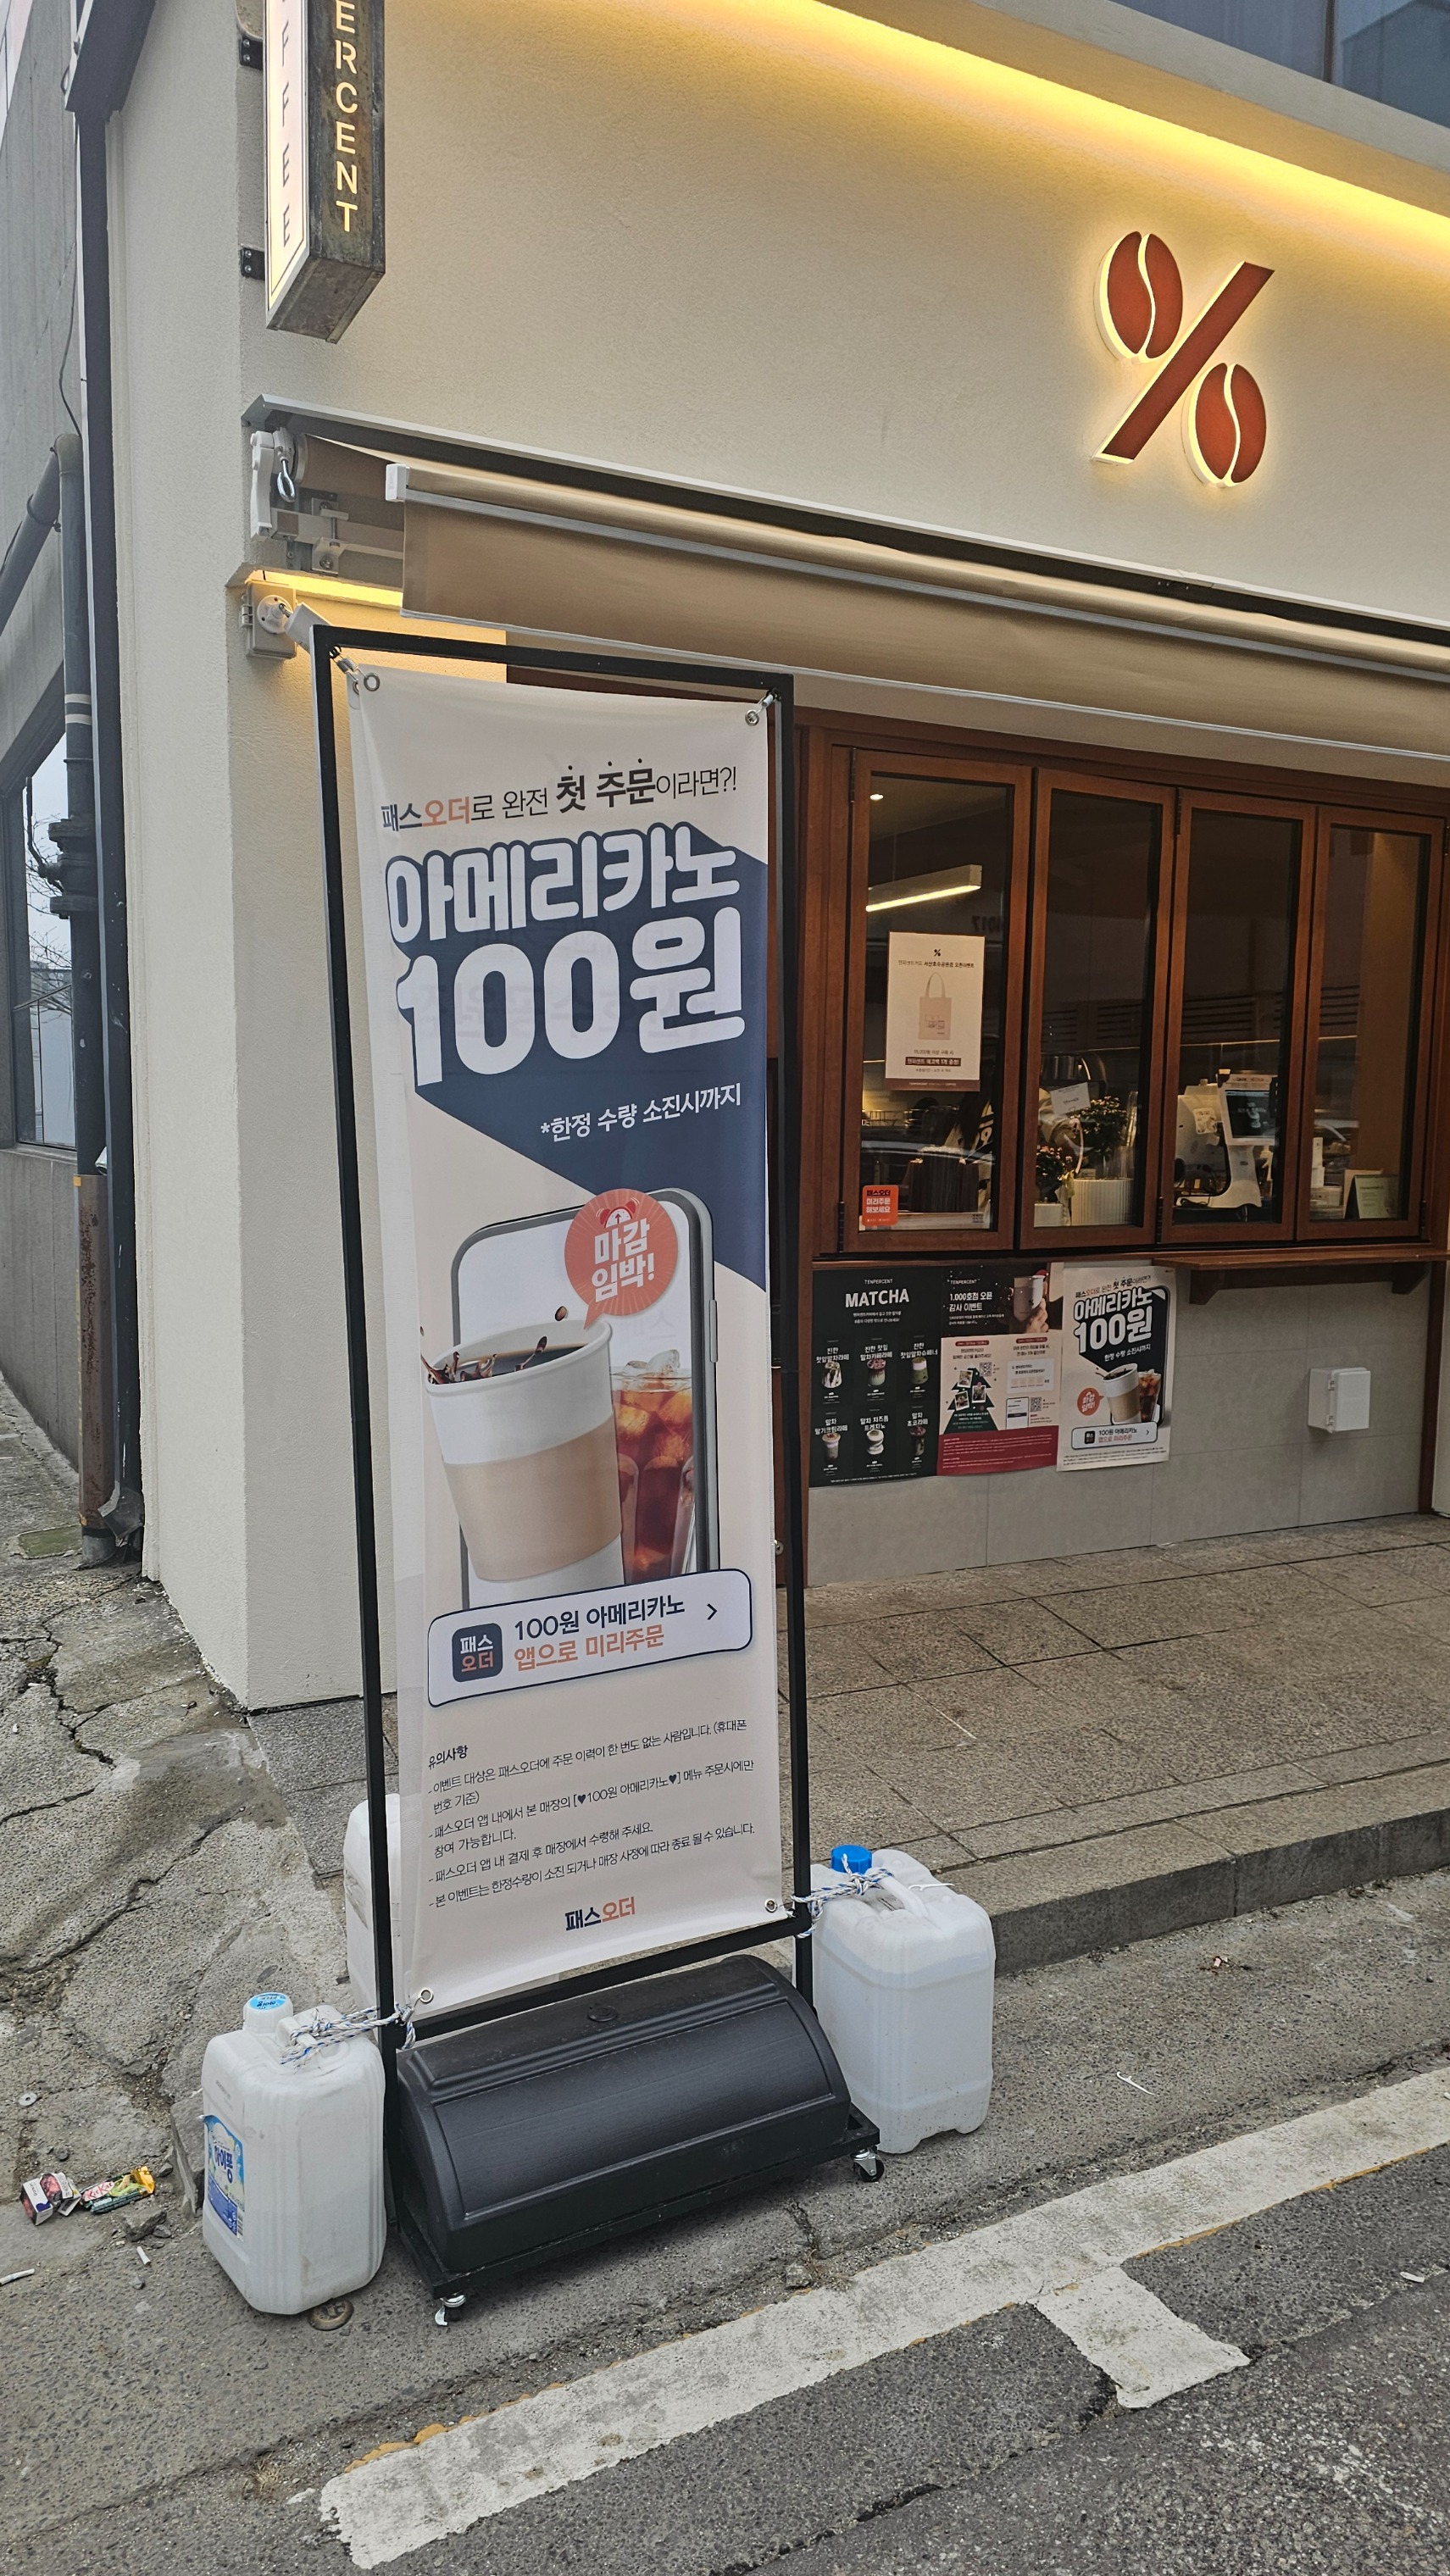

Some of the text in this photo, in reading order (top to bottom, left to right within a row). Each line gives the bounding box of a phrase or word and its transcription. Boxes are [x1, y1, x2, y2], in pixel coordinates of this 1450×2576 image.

[281, 0, 290, 247] FFEE
[381, 766, 736, 831] 패스오더로 완전 첫 주문이라면?!
[386, 824, 741, 944] 아메리카노
[396, 906, 746, 1086] 100원
[597, 1103, 637, 1132] 수량
[642, 1083, 741, 1123] 소진시까지
[866, 1197, 891, 1206] 미리주문
[594, 1218, 650, 1265] 마감
[592, 1252, 655, 1302] 임박!
[845, 1288, 910, 1308] MATCHA
[980, 1291, 993, 1301] 오픈
[1113, 1280, 1119, 1289] 첫
[949, 1302, 983, 1313] 감사 이벤트
[1074, 1286, 1153, 1321] 아메리카노
[1074, 1306, 1153, 1353] 100원
[1126, 1344, 1151, 1356] 소진시까지
[514, 1594, 685, 1641] 100원 아메리카노
[459, 1634, 494, 1655] 패스
[461, 1654, 495, 1674] 오더
[514, 1624, 665, 1672] 앱으로 미리주문
[428, 1745, 468, 1769] 유의사항
[464, 1768, 496, 1785] 대상은
[498, 1757, 550, 1778] 패스오더에
[553, 1752, 574, 1768] 주문
[575, 1745, 605, 1762] 이력이
[608, 1743, 619, 1757] 한
[620, 1739, 640, 1754] 번도
[642, 1735, 662, 1749] 없는
[663, 1724, 712, 1743] 사람입니다.
[714, 1719, 747, 1735] (휴대폰
[433, 1790, 480, 1815] 번호 기준)
[477, 1814, 489, 1828] 앱
[492, 1806, 524, 1824] 내에서
[525, 1804, 536, 1817] 본
[540, 1796, 570, 1813] 매장의
[683, 1768, 703, 1781] 메뉴
[704, 1759, 754, 1777] 주문시에만
[435, 1829, 517, 1859] 참여 가능합니다.
[436, 1895, 446, 1908] 본
[447, 1885, 489, 1903] 이벤트는
[492, 1871, 542, 1894] 한정수량이
[544, 1865, 565, 1881] 소진
[567, 1857, 597, 1875] 되거나
[598, 1852, 618, 1867] 매장
[619, 1846, 649, 1863] 사정에
[651, 1840, 669, 1854] 따라
[671, 1835, 691, 1851] 종료
[715, 1823, 755, 1840] 있습니다.
[480, 1857, 491, 1872] 앱
[494, 1855, 505, 1868] 내
[508, 1849, 530, 1865] 결제
[532, 1846, 543, 1859] 후
[546, 1836, 586, 1856] 매장에서
[589, 1829, 619, 1846] 수령해
[564, 1896, 636, 1932] 패스오더
